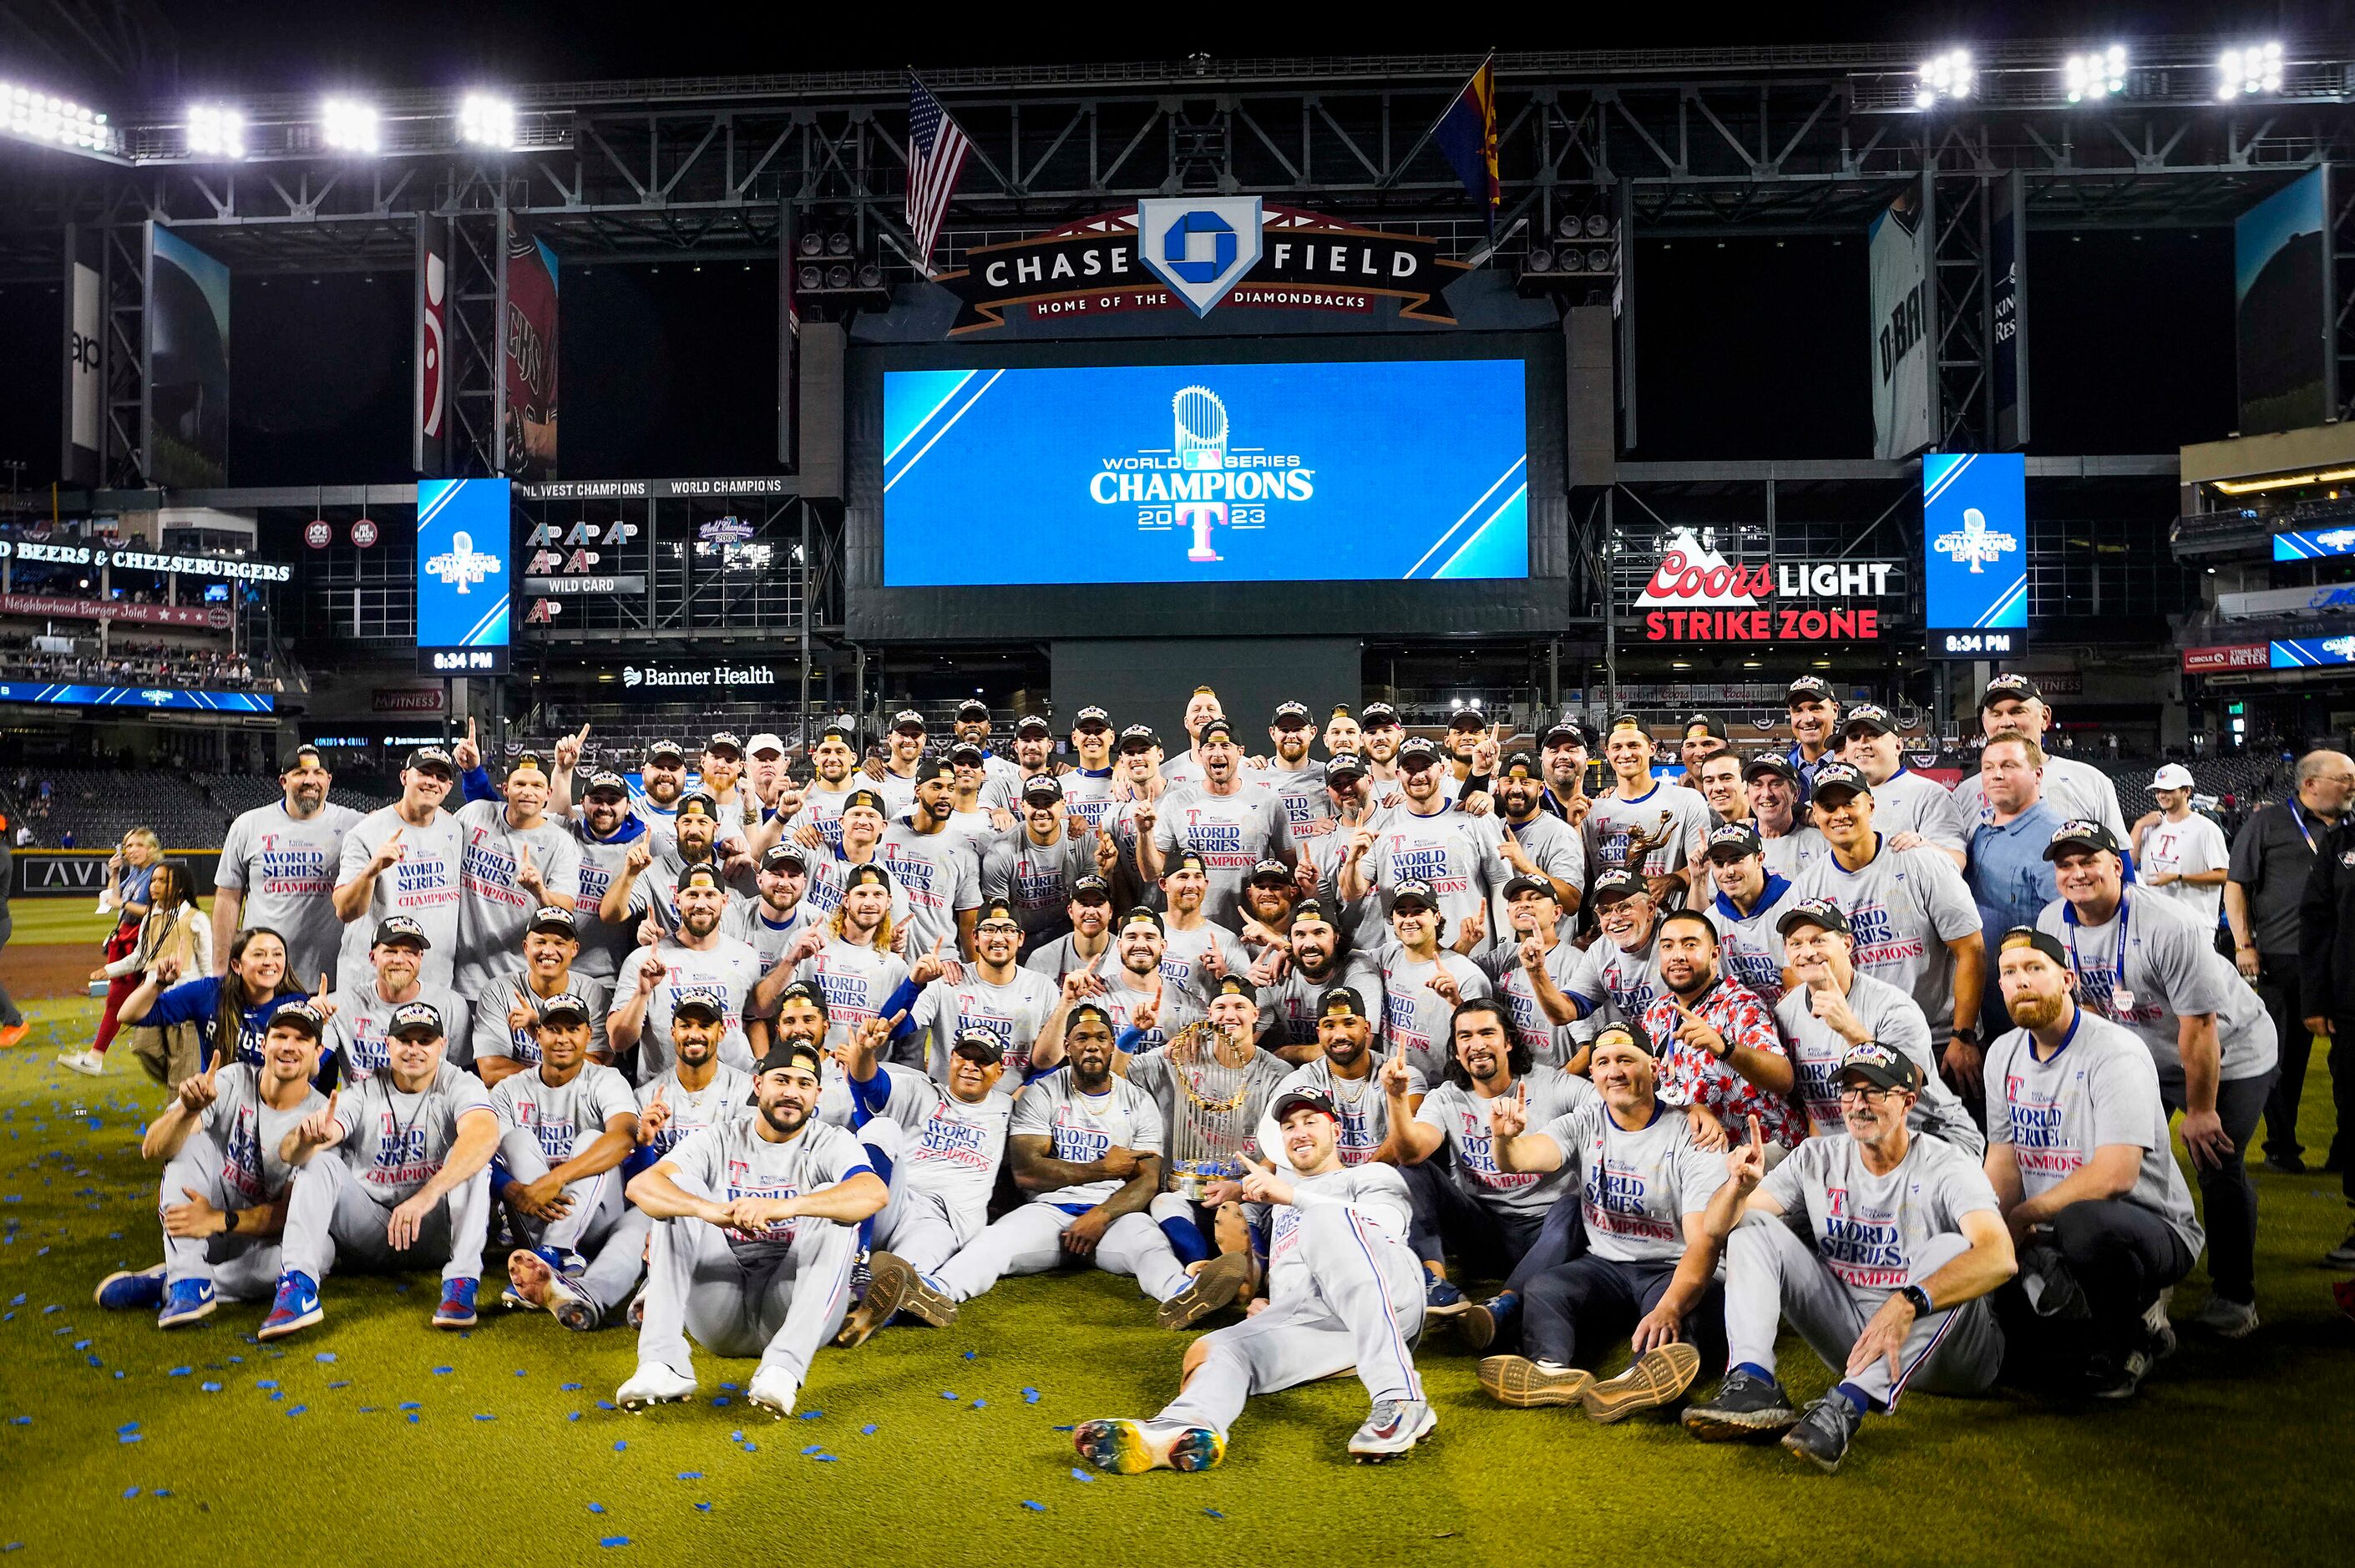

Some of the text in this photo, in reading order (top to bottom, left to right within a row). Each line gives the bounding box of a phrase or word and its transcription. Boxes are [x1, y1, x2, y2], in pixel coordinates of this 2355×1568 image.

[985, 243, 1418, 287] CHASE FIELD
[1037, 292, 1366, 315] HOME OF THE DIAMONDBACKS
[1102, 455, 1301, 469] WORLD SERIES
[523, 483, 646, 497] NL WEST CHAMPIONS
[671, 479, 782, 493] WORLD CHAMPIONS
[1090, 470, 1314, 504] CHAMPIONS
[1137, 508, 1266, 525] 20 23
[354, 531, 374, 539] BLACK
[700, 518, 753, 535] World Champions
[17, 543, 90, 565] BEERS
[94, 550, 109, 566] &
[112, 551, 291, 582] CHEESEBURGERS
[1646, 549, 1892, 599] Coors LIGHT
[549, 578, 615, 592] WILD CARD
[5, 595, 148, 620] Neighborhood Burger Joint
[1646, 609, 1879, 641] STRIKE ZONE
[1946, 635, 2010, 652] 8:34 PM
[434, 651, 493, 670] 8:34 PM
[2189, 655, 2213, 664] CIRCLE
[2229, 654, 2267, 667] METER
[645, 665, 774, 686] Banner Health
[390, 696, 434, 708] FITNESS
[812, 822, 844, 833] WOR
[1188, 826, 1240, 839] WORLD
[1188, 838, 1240, 852] SERIES
[262, 852, 324, 865] WORLD
[467, 845, 516, 873] WORLD
[1203, 856, 1257, 867] AMPIONS
[1392, 849, 1446, 867] WORLD
[1598, 847, 1628, 862] SERI
[262, 865, 325, 878] SERIES
[398, 862, 445, 878] WORLD
[462, 858, 511, 887] SERIES
[885, 860, 934, 878] WORLD
[1394, 862, 1447, 882] SERIES
[398, 875, 446, 892] SERIES
[398, 889, 462, 907] CHAMPIONS
[1851, 909, 1888, 930] ORLD
[1851, 942, 1924, 966] HAMPIONS
[814, 974, 868, 994] WORLD
[823, 989, 867, 1008] ERIES
[1386, 992, 1416, 1015] ORLD
[928, 1119, 986, 1141] WORLD
[1053, 1126, 1109, 1150] WORLD
[1584, 1203, 1675, 1242] CHAMPIONS
[1826, 1216, 1898, 1246] WORLD
[1819, 1236, 1902, 1267] SERIES
